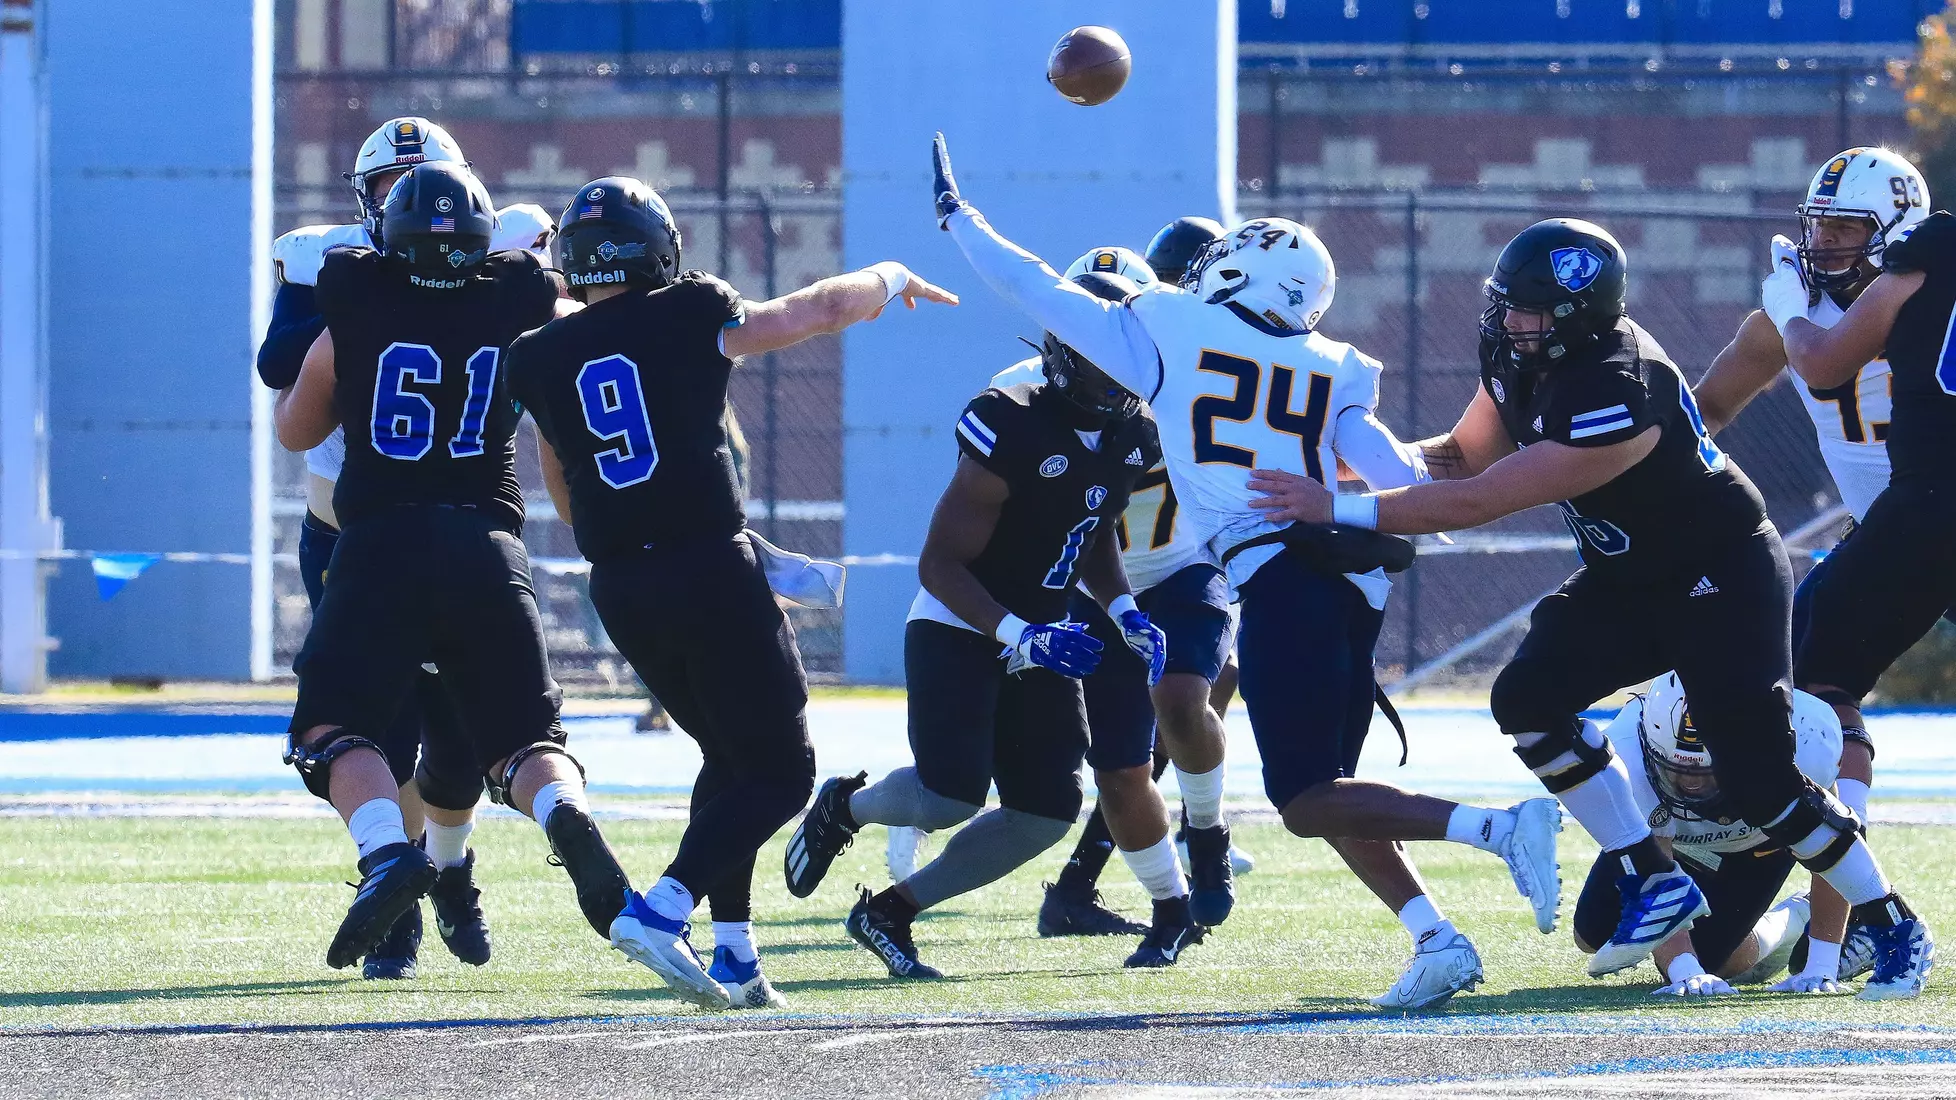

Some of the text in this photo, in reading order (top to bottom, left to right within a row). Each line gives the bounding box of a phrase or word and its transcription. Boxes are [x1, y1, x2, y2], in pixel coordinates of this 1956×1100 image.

[395, 154, 425, 164] Riddell
[1889, 175, 1921, 210] 93
[1236, 221, 1287, 251] 24
[439, 244, 450, 253] 61
[410, 275, 466, 289] Riddell
[570, 269, 627, 286] Riddell
[369, 341, 500, 461] 61
[575, 353, 660, 490] 9
[1190, 347, 1334, 488] 24
[1124, 457, 1144, 466] adidas
[1041, 516, 1100, 590] 1
[1689, 586, 1720, 597] adidas
[1672, 829, 1733, 845] MURRAY
